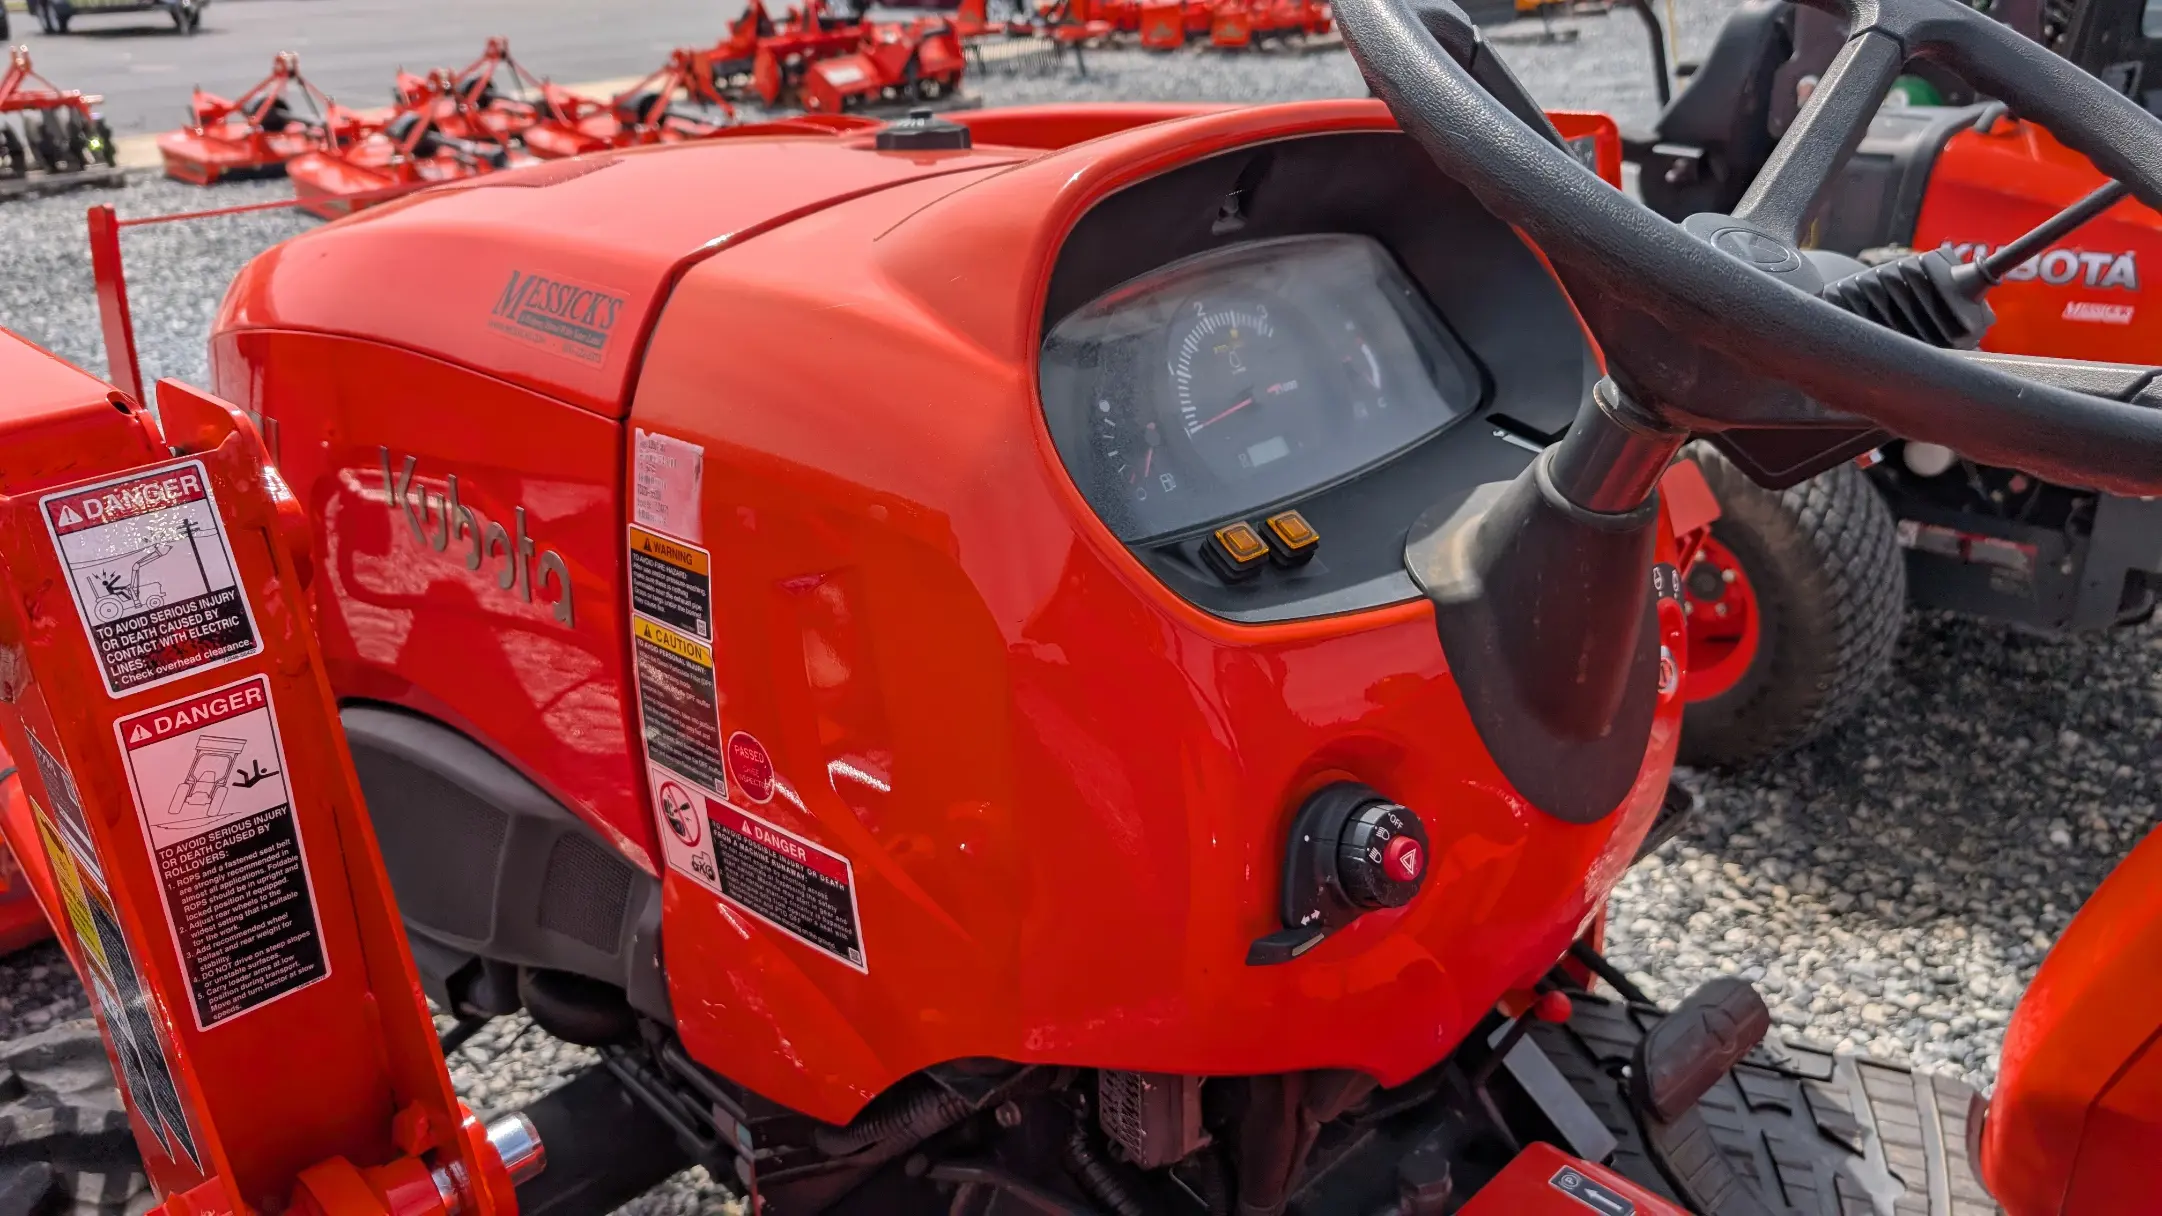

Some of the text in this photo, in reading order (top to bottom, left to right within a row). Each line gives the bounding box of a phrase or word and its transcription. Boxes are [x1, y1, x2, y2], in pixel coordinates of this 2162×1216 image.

[492, 270, 623, 330] MESSICK'S
[1194, 302, 1206, 316] 2
[82, 474, 200, 520] DANGER
[380, 445, 574, 628] Kubota
[653, 541, 693, 566] WARNING
[96, 590, 234, 638] TO AVOID SERIOUS INJURY
[101, 607, 218, 651] OR DEATH CAUSED BY
[106, 615, 239, 663] CONTACT WITH ELECTRIC
[656, 630, 702, 660] CAUTION
[121, 668, 154, 684] Check
[155, 652, 201, 673] overhead
[154, 687, 262, 734] DANGER
[734, 744, 765, 764] PASSED
[158, 806, 286, 859] TO AVOID SERIOUS INJURY
[754, 825, 807, 862] DANGER
[1390, 814, 1404, 829] OFF
[161, 822, 269, 869] OR DEATH CAUSED BY
[164, 850, 228, 879] ROLLOVERS:
[176, 872, 200, 886] ROPS
[202, 865, 216, 877] and
[224, 850, 257, 868] fastened
[259, 844, 275, 855] seat
[275, 838, 290, 848] belt
[712, 820, 720, 829] TO
[722, 826, 741, 840] AVOID
[743, 836, 776, 858] POSSIBLE
[779, 855, 803, 871] INJURY
[806, 868, 817, 877] OR
[819, 874, 844, 890] DEATH
[713, 829, 731, 843] FROM
[739, 842, 769, 862] MACHINE
[771, 859, 807, 881] RUNAWAY:
[179, 886, 192, 895] are
[193, 873, 225, 890] strongly
[227, 851, 280, 876] recommended
[181, 855, 298, 904] almost all applications. Foldable
[183, 898, 207, 912] ROPS
[208, 887, 235, 903] should
[236, 884, 246, 892] be
[256, 869, 283, 884] upright
[284, 862, 298, 873] and
[185, 905, 212, 921] locked
[213, 894, 244, 912] position
[252, 876, 289, 894] equipped.
[189, 914, 214, 929] Adjust
[215, 908, 230, 919] rear
[231, 898, 258, 912] wheels
[268, 889, 281, 897] the
[190, 923, 216, 938] widest
[217, 913, 243, 927] setting
[244, 906, 259, 916] that
[269, 891, 298, 907] suitable
[192, 924, 240, 946] for the work.
[195, 943, 211, 955] Add
[212, 921, 265, 947] recommended
[266, 911, 288, 925] wheel
[197, 920, 292, 963] ballast and rear weight for
[201, 969, 214, 980] DO
[215, 961, 232, 973] NOT
[234, 954, 253, 966] drive
[265, 941, 285, 953] steep
[286, 930, 310, 944] slopes
[199, 955, 230, 971] stability.
[206, 983, 226, 995] Carry
[228, 972, 251, 986] loader
[253, 964, 271, 975] arms
[272, 959, 280, 967] at
[281, 954, 294, 964] low
[208, 960, 300, 1005] position during transport.
[214, 966, 246, 983] unstable
[247, 952, 280, 969] surfaces.
[210, 999, 231, 1012] Move
[232, 991, 246, 1002] and
[247, 985, 263, 995] turn
[263, 974, 287, 988] tractor
[289, 970, 296, 978] at
[297, 963, 314, 974] slow
[212, 1004, 241, 1019] speeds.
